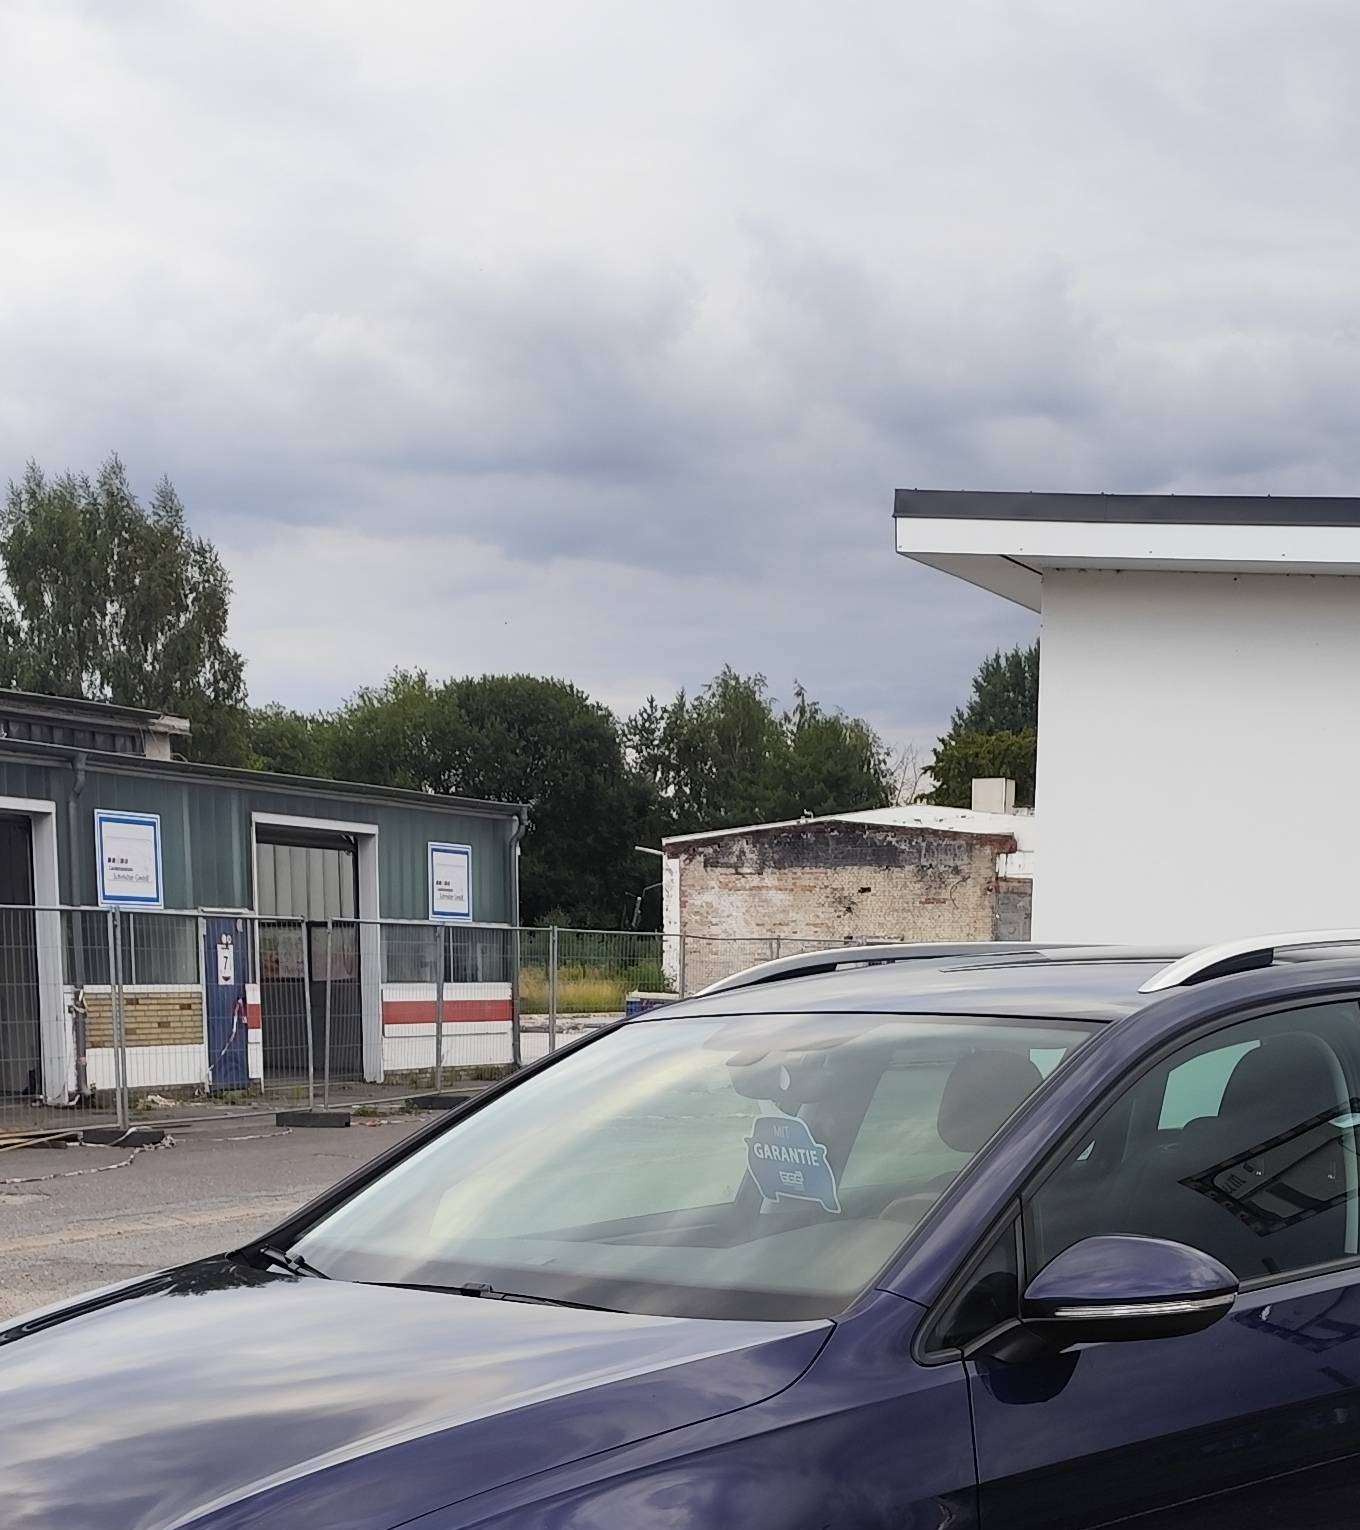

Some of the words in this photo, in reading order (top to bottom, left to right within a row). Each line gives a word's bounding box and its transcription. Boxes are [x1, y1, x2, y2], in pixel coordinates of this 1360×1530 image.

[223, 955, 229, 970] 7
[772, 1125, 790, 1139] MIT
[753, 1142, 820, 1166] GARANTIE
